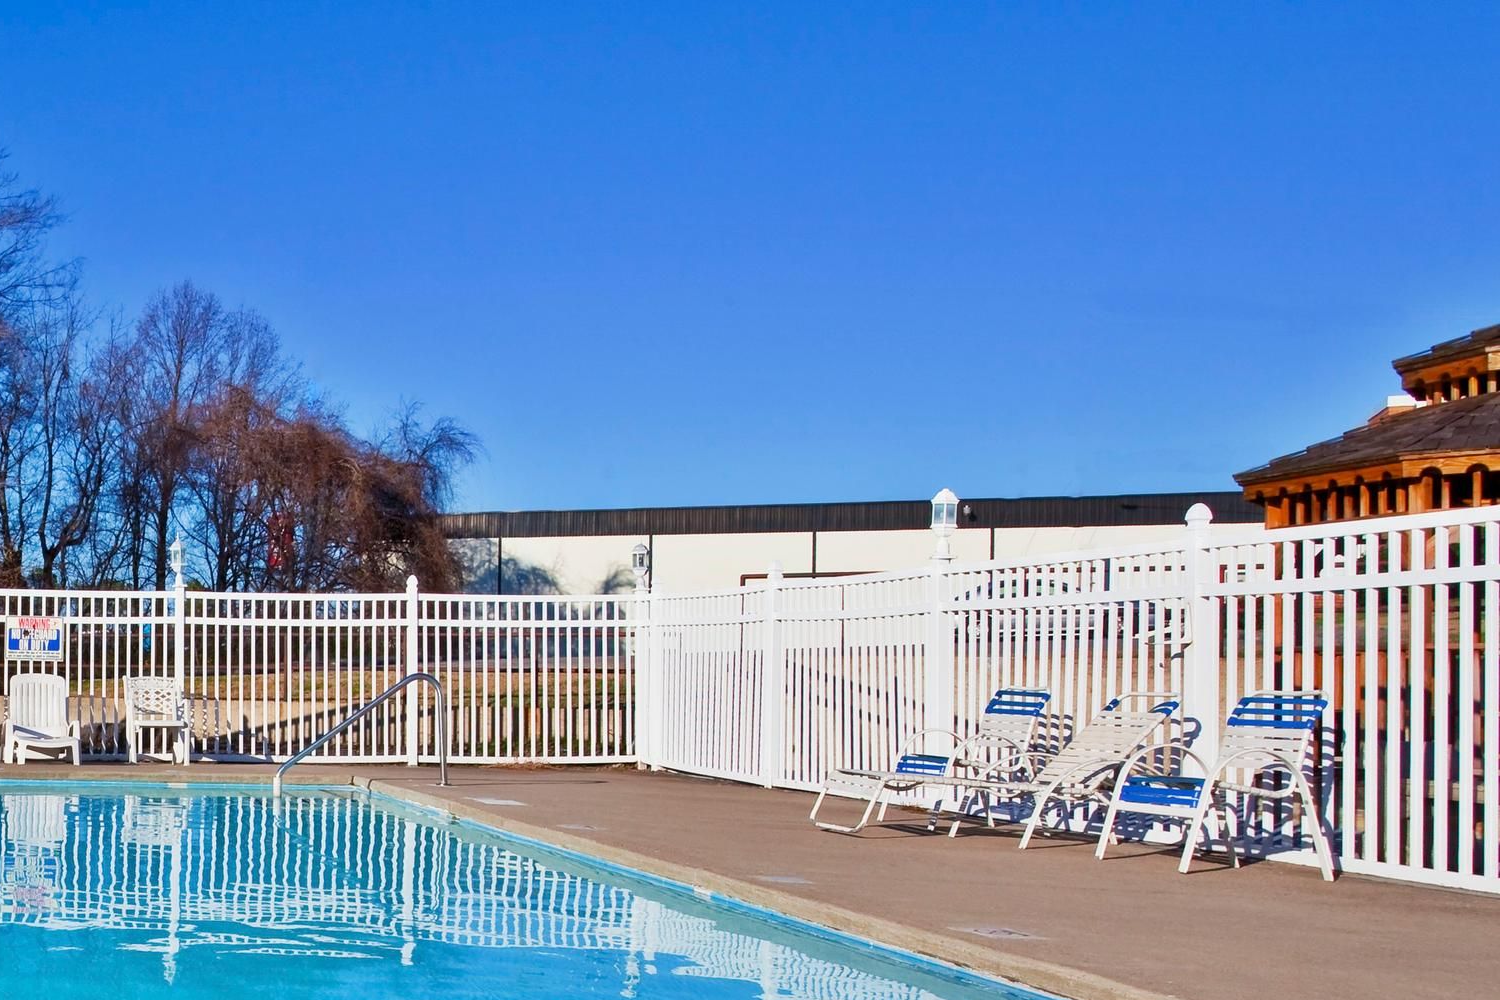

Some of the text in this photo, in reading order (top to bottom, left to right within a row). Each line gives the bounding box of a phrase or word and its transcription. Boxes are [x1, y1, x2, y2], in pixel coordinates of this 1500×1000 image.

[18, 618, 50, 629] WARNING
[11, 628, 58, 640] NO LFEGUARD
[18, 639, 50, 651] ON DUTY
